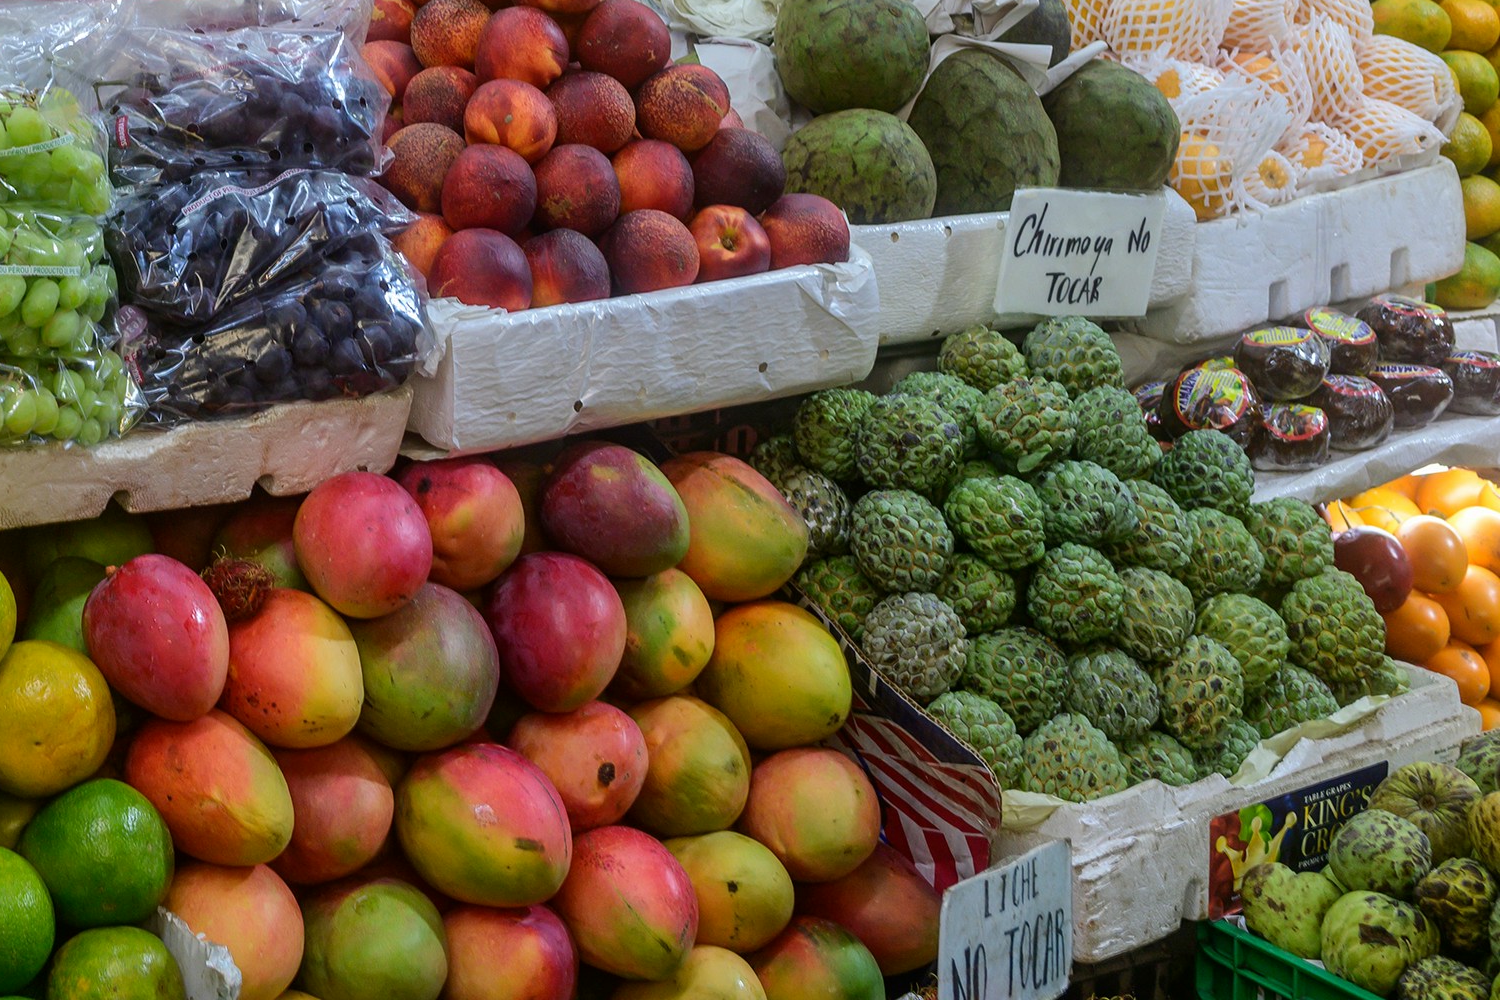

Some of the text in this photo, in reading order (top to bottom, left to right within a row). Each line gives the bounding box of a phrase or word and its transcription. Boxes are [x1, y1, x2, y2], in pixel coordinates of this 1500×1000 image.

[183, 194, 213, 215] PRODUCT
[213, 187, 223, 199] OF
[1013, 202, 1113, 276] Chirimoya
[1045, 271, 1103, 306] TOCAR
[1303, 784, 1373, 830] KING'S
[1304, 781, 1352, 804] TABLE GRAPES
[984, 856, 1040, 918] LICHE
[951, 907, 1066, 1000] NO TOCAR
